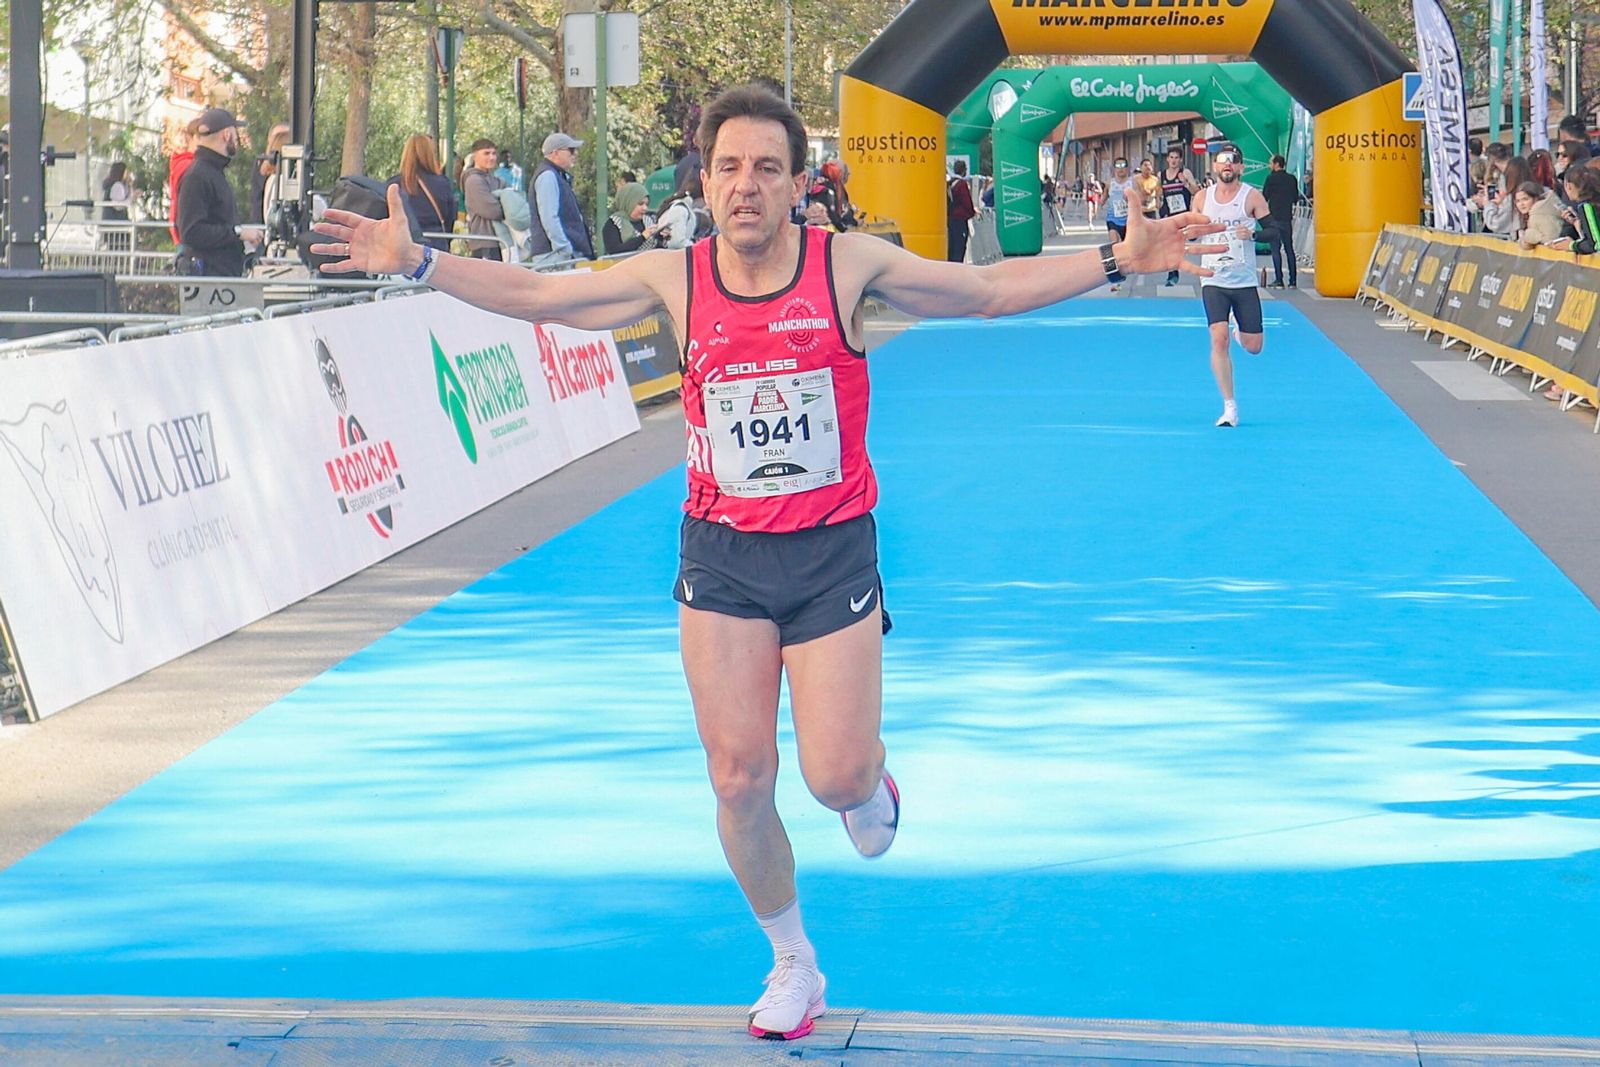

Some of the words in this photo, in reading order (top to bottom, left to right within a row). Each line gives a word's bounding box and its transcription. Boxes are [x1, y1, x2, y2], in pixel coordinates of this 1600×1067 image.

[1039, 11, 1225, 30] www.mpmarcelino.es
[1070, 77, 1090, 97] El
[1090, 78, 1134, 97] Corte
[1135, 74, 1199, 104] Inglés
[847, 131, 937, 156] agustinos
[1325, 129, 1416, 154] agustinos
[858, 155, 926, 164] GRANADA
[1338, 153, 1407, 162] GRANADA
[768, 318, 830, 333] MANCHATHON
[540, 328, 615, 402] Alcampo
[724, 358, 798, 376] SOLISS
[730, 413, 810, 449] 1941
[90, 411, 231, 511] VÍLCHEZ
[763, 449, 785, 458] FRAN
[335, 441, 393, 494] RODICH
